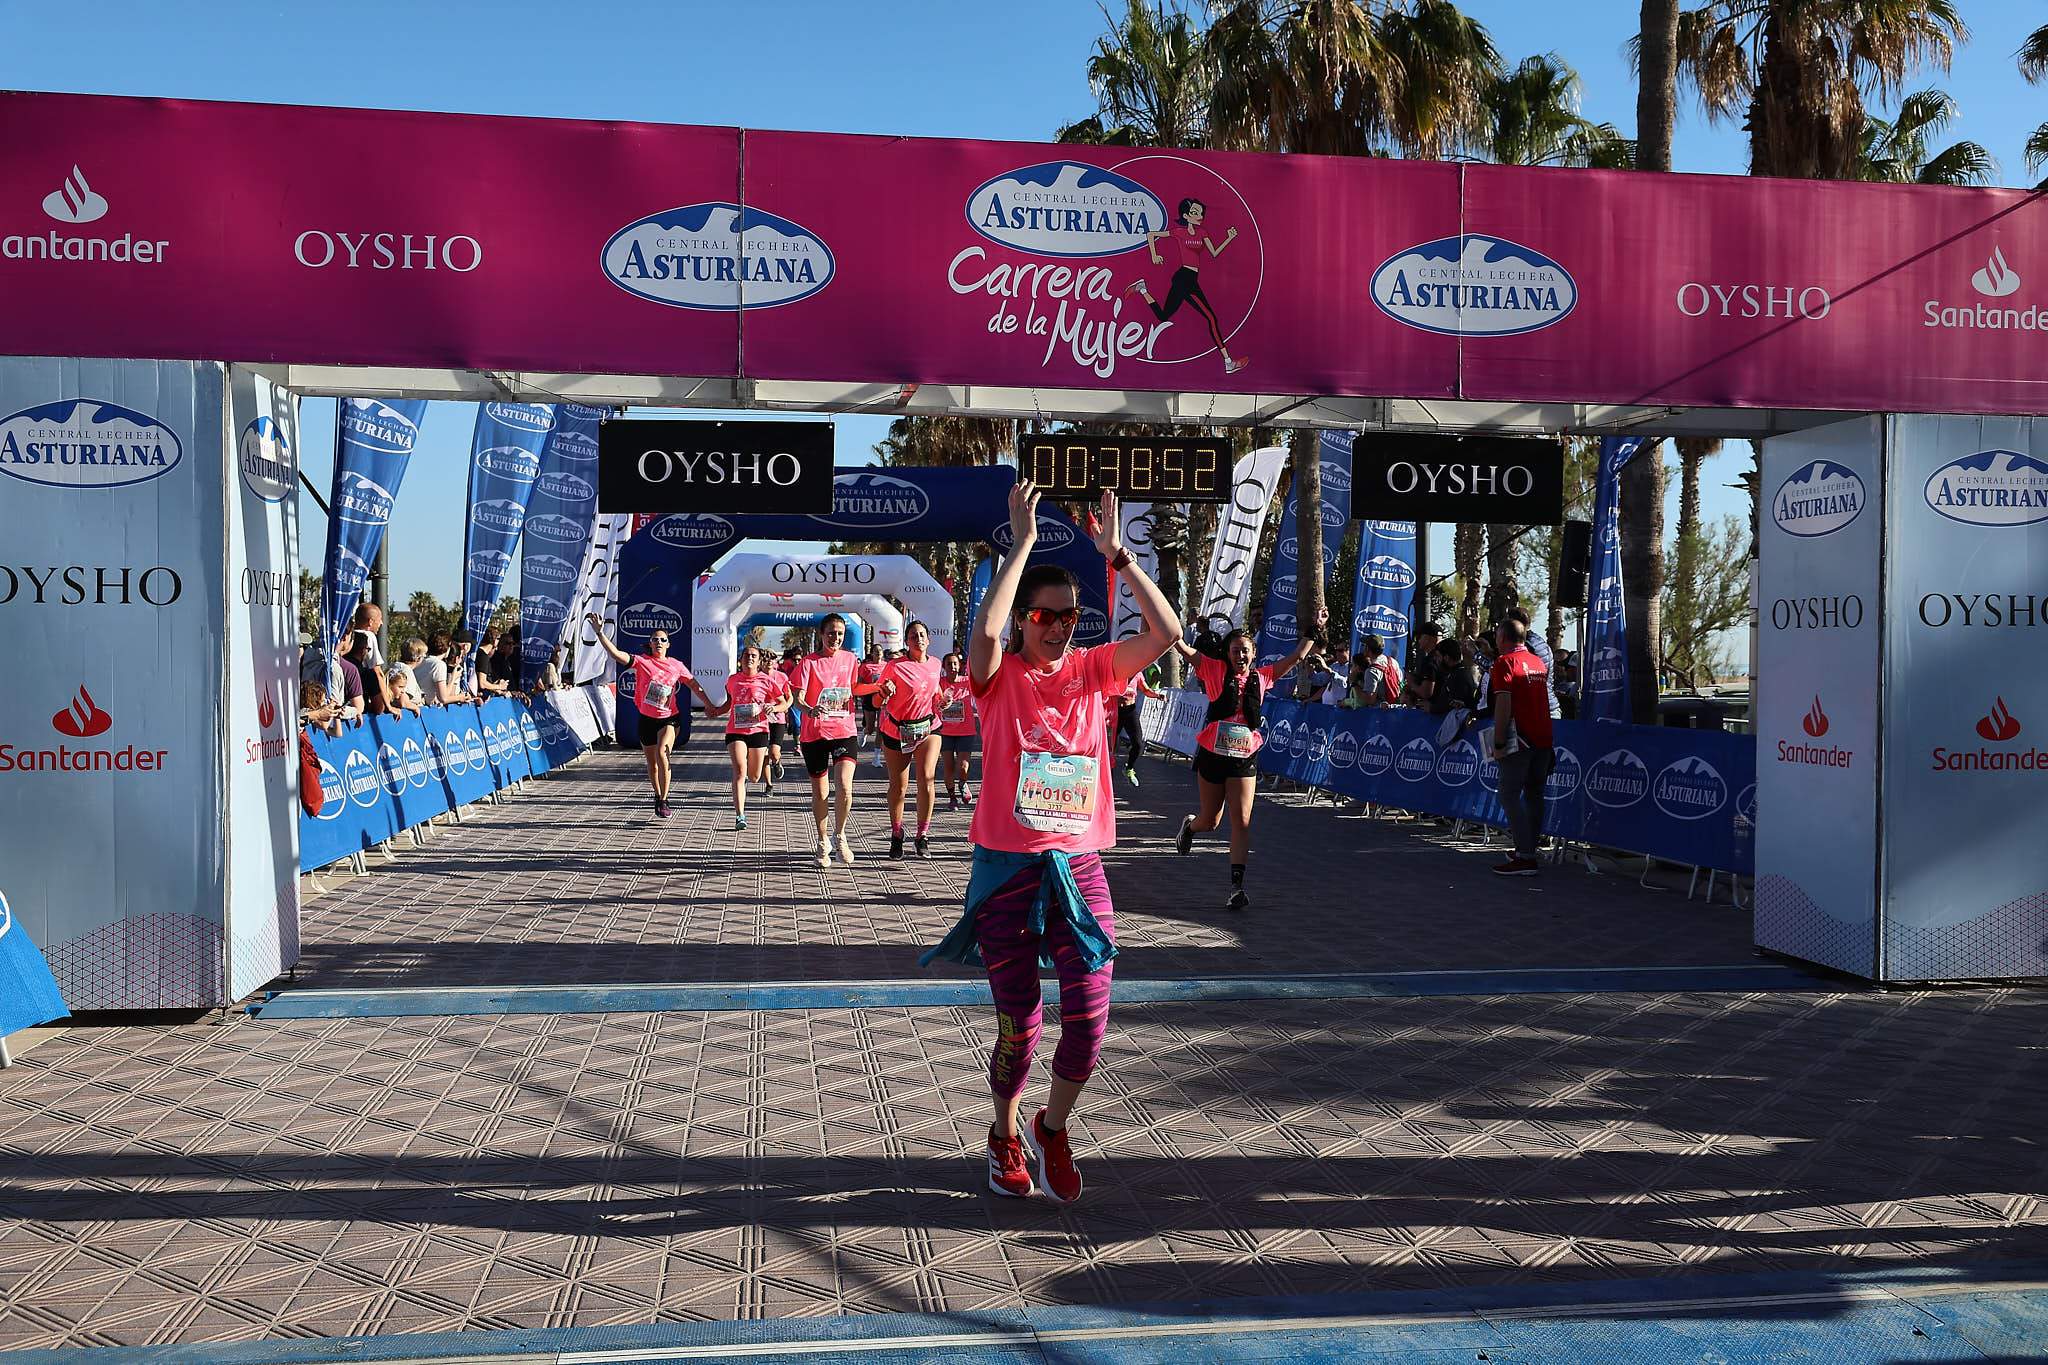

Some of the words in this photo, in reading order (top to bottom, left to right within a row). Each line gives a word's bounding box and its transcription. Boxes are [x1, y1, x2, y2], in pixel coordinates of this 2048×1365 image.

[982, 192, 1150, 234] ASTURIANA
[1013, 192, 1077, 204] CENTRAL
[1083, 196, 1146, 208] LECHERA
[2, 231, 169, 263] antander
[294, 230, 482, 272] OYSHO
[656, 238, 729, 250] CENTRAL
[744, 240, 810, 252] ECHERA
[620, 239, 817, 284] ASTURIANA
[948, 246, 1112, 300] Carrera
[1419, 268, 1483, 279] CENTRAL
[1490, 270, 1555, 282] LECHERA
[1386, 269, 1561, 311] ASTURIANA
[1677, 283, 1831, 320] OYSHO
[1924, 300, 2048, 330] Santande
[988, 300, 1018, 333] de
[1026, 300, 1047, 335] la
[1042, 298, 1173, 378] Mujer
[492, 402, 551, 428] ASTURIAN
[0, 430, 167, 466] ASTURIANA
[28, 429, 91, 439] CENTRAL
[98, 430, 160, 440] LECHERA
[482, 454, 537, 478] ASTURIAN
[638, 450, 800, 486] OYSHO
[1034, 447, 1216, 490] 00:38:52
[1387, 462, 1533, 498] OYSHO
[1934, 478, 2048, 508] ASTURIAN
[1958, 476, 2005, 485] CENTRAL
[2010, 477, 2048, 485] LECHE
[835, 497, 919, 514] TURIANA
[1778, 492, 1858, 522] ASTURIANA
[529, 520, 580, 540] ASTURIANA
[655, 523, 728, 539] ASTURIANA
[522, 561, 573, 580] ASTURIANA
[772, 562, 876, 584] OYSHO
[241, 567, 293, 608] OYSHO
[709, 585, 741, 593] OYSHO
[904, 585, 936, 593] OYSHO
[621, 615, 679, 629] ASTURIANA
[1772, 595, 1863, 630] OYSHO
[1919, 593, 2048, 628] OYSH
[694, 626, 724, 634] OYSHO
[693, 668, 723, 677] OYSHO
[0, 744, 168, 771] Santander
[247, 735, 290, 763] Santander
[1777, 740, 1853, 769] Santander
[1932, 747, 2048, 771] Santande
[1043, 787, 1072, 802] 016
[1589, 768, 1643, 796] ASTURIANA
[1657, 776, 1718, 807] ASTURIANA
